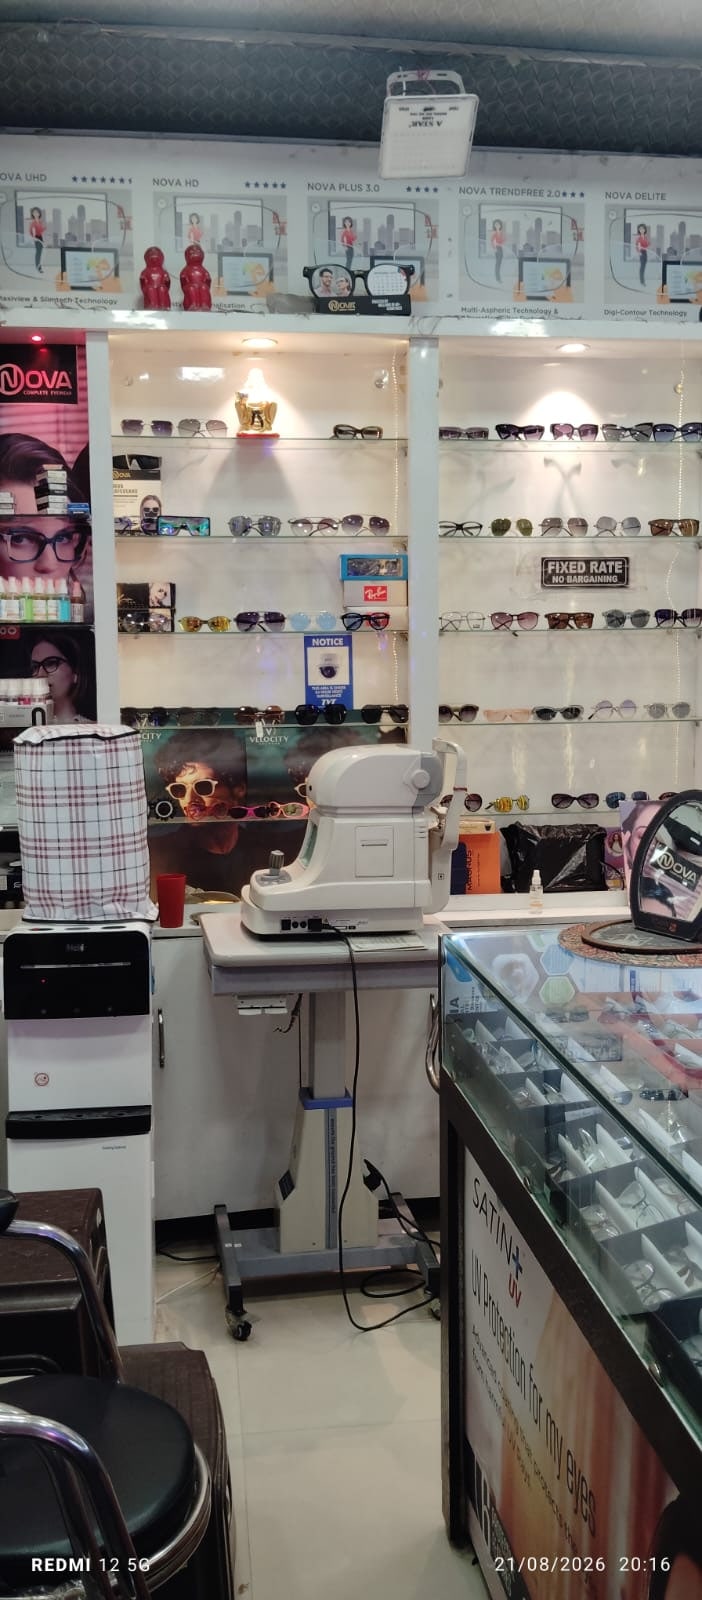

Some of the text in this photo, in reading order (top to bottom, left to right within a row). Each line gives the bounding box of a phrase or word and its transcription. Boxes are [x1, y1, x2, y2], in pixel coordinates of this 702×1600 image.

[0, 172, 47, 182] OVA UHD
[152, 177, 199, 188] NOVA HD
[307, 183, 380, 193] NOVA PLUS 3.0
[458, 186, 561, 198] NOVA TRENDFREE 2.0
[605, 191, 667, 201] NOVA DELITE
[74, 297, 118, 305] Technology
[512, 307, 552, 315] Technology
[603, 309, 688, 317] Digi-Contour Technology
[0, 363, 73, 397] NOVA
[547, 561, 623, 574] FIXED RATE
[552, 575, 618, 583] NO BARGAINING
[312, 638, 344, 646] NOTICE
[249, 736, 289, 744] VELOCITY
[657, 851, 697, 884] NOVA
[508, 1273, 522, 1309] UV
[472, 1249, 482, 1306] UV
[483, 1272, 526, 1402] Protection
[528, 1362, 543, 1433] for
[546, 1408, 563, 1481] my
[567, 1449, 596, 1538] eyes
